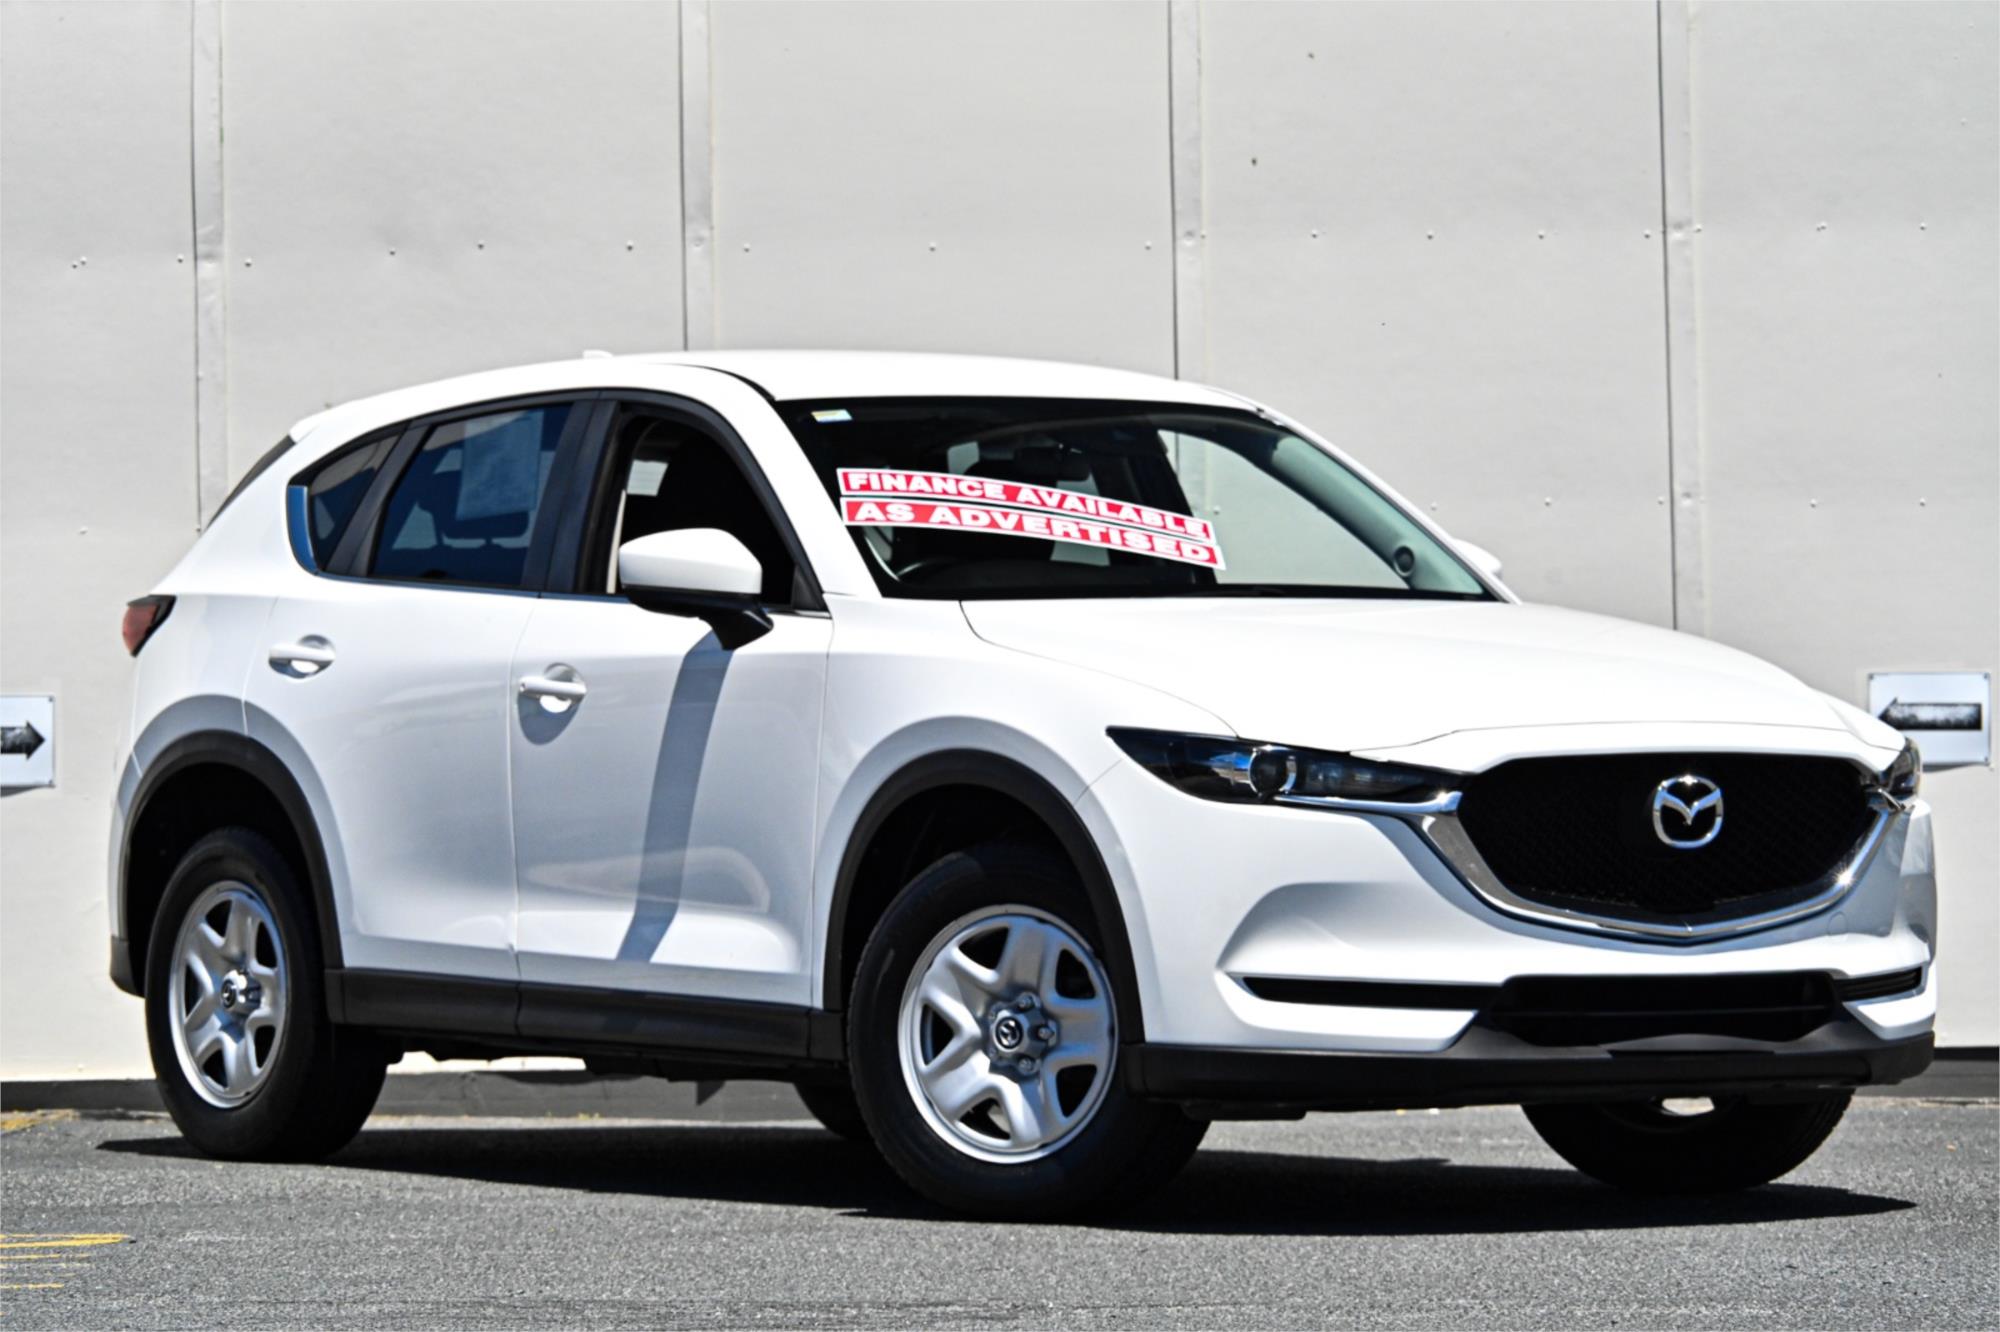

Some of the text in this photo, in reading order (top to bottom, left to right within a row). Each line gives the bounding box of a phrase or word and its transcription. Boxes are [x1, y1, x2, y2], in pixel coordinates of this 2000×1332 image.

[847, 472, 1207, 539] FINANCE AVAILABLE
[854, 502, 1211, 561] AS ADVERTISED
